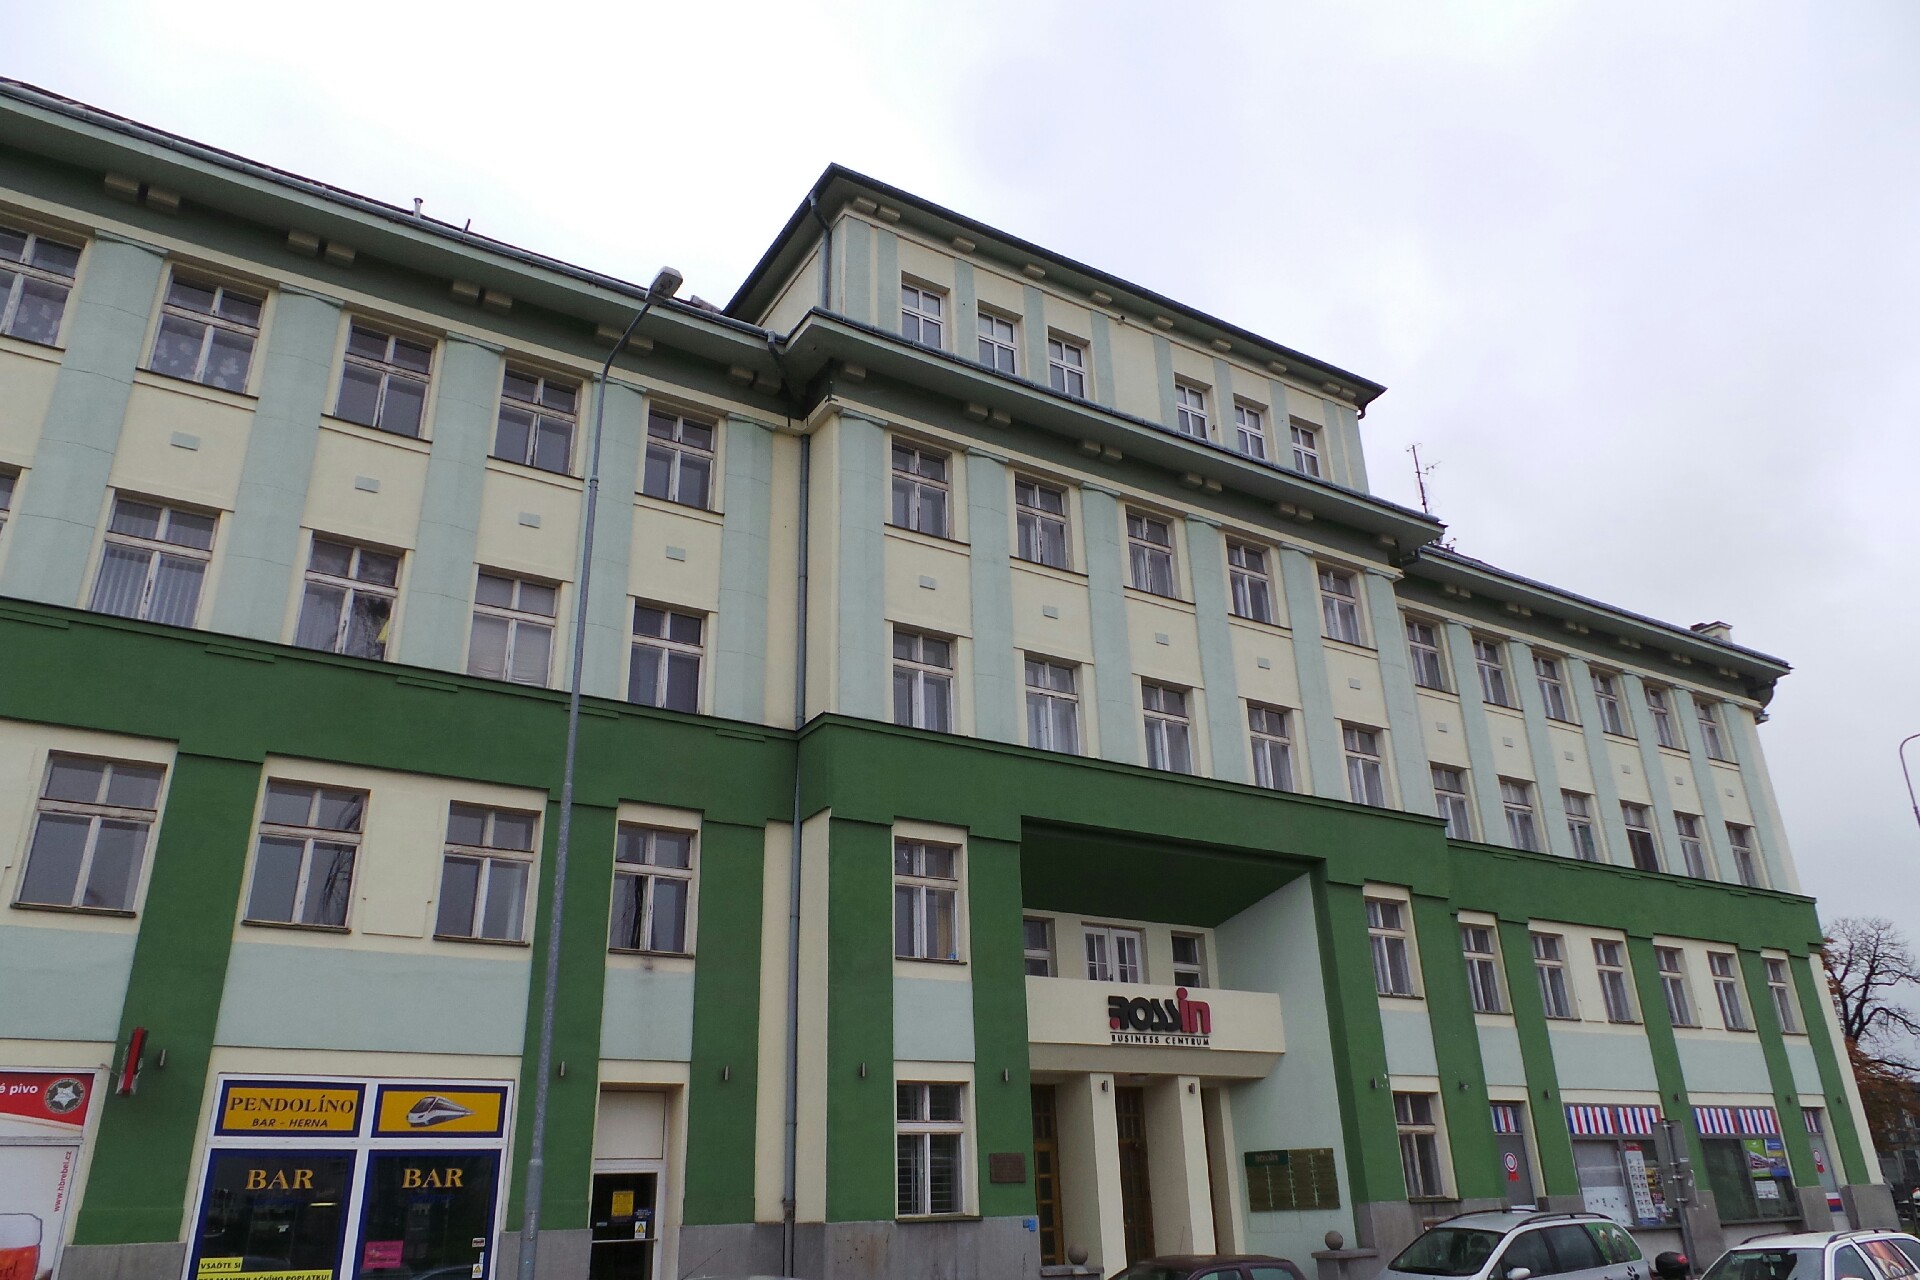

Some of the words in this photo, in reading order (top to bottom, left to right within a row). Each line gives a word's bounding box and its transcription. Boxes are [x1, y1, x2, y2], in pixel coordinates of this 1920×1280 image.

[1112, 1034, 1160, 1044] BUSINESS
[1166, 1036, 1209, 1046] CENTRUM
[9, 1083, 39, 1096] pivo
[230, 1094, 354, 1114] PENDOLÍNO
[252, 1118, 276, 1127] BAR
[289, 1118, 328, 1128] HERNA
[245, 1169, 314, 1190] BAR
[401, 1168, 463, 1188] BAR
